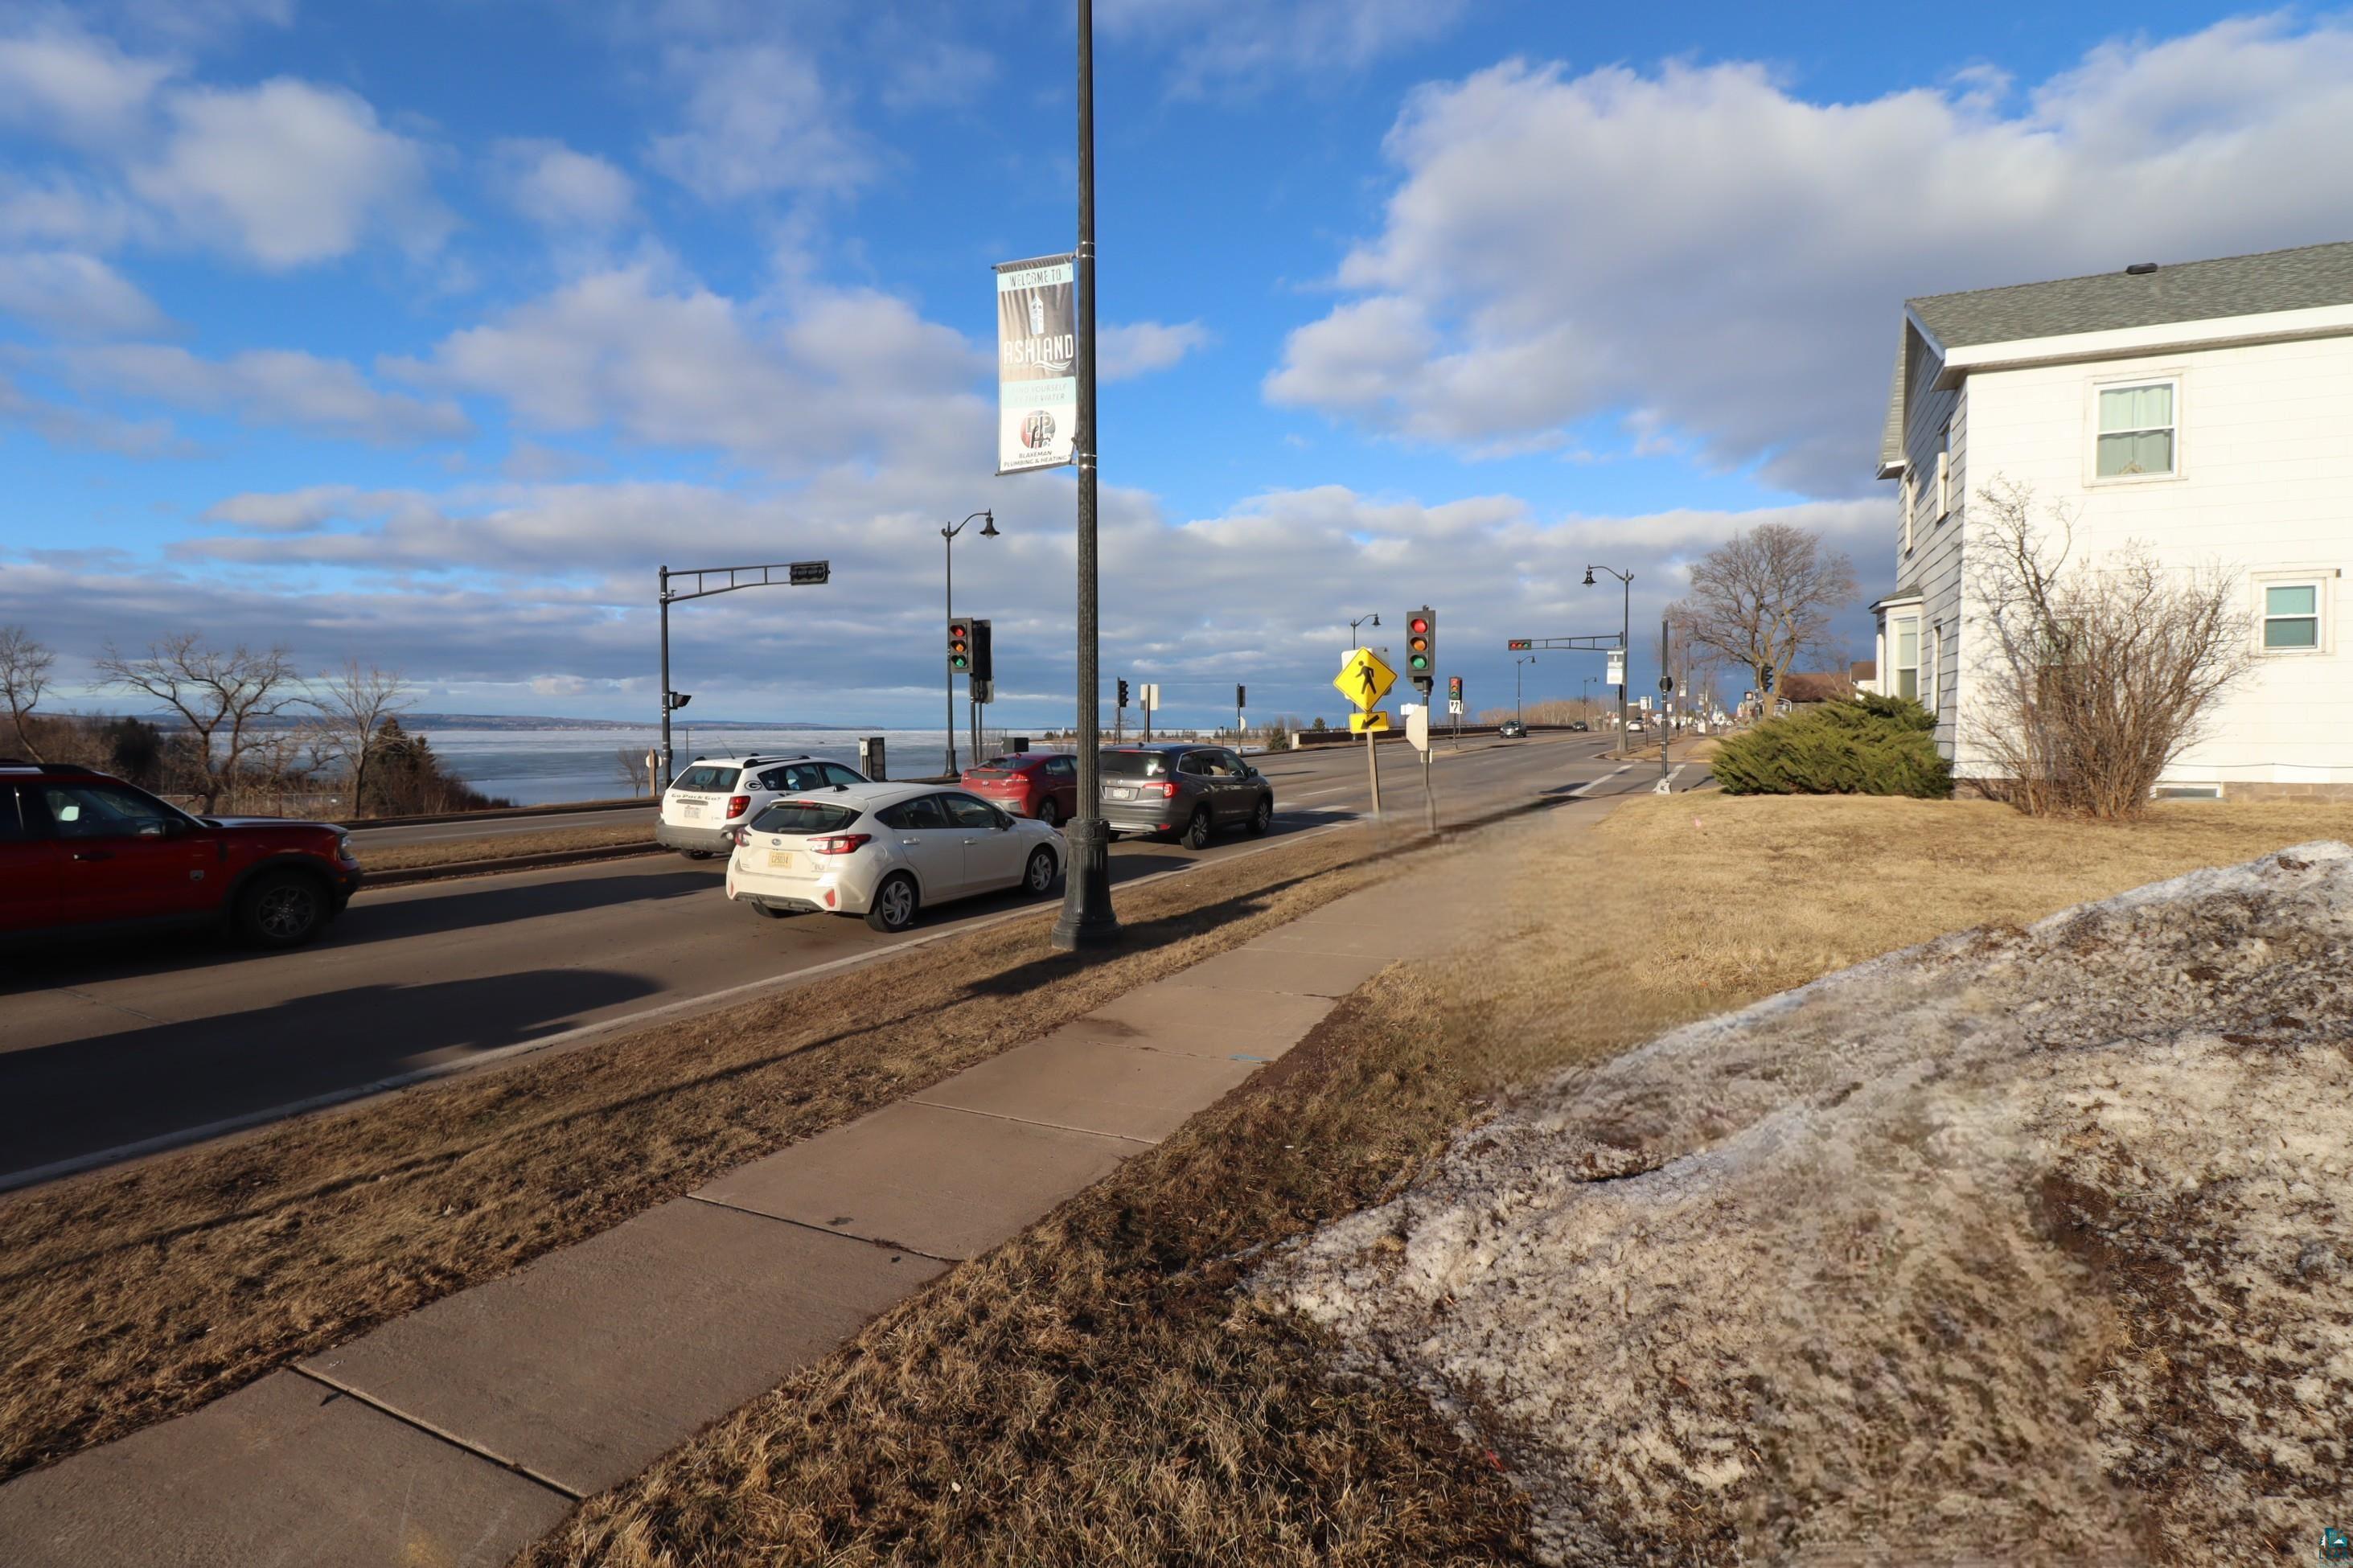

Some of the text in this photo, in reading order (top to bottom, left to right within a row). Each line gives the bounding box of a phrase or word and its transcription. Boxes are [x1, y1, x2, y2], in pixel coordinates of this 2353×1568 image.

[1009, 269, 1062, 288] WELCOME TO
[1003, 334, 1074, 365] ASHLAND
[1018, 450, 1053, 459] BLAKEMAN
